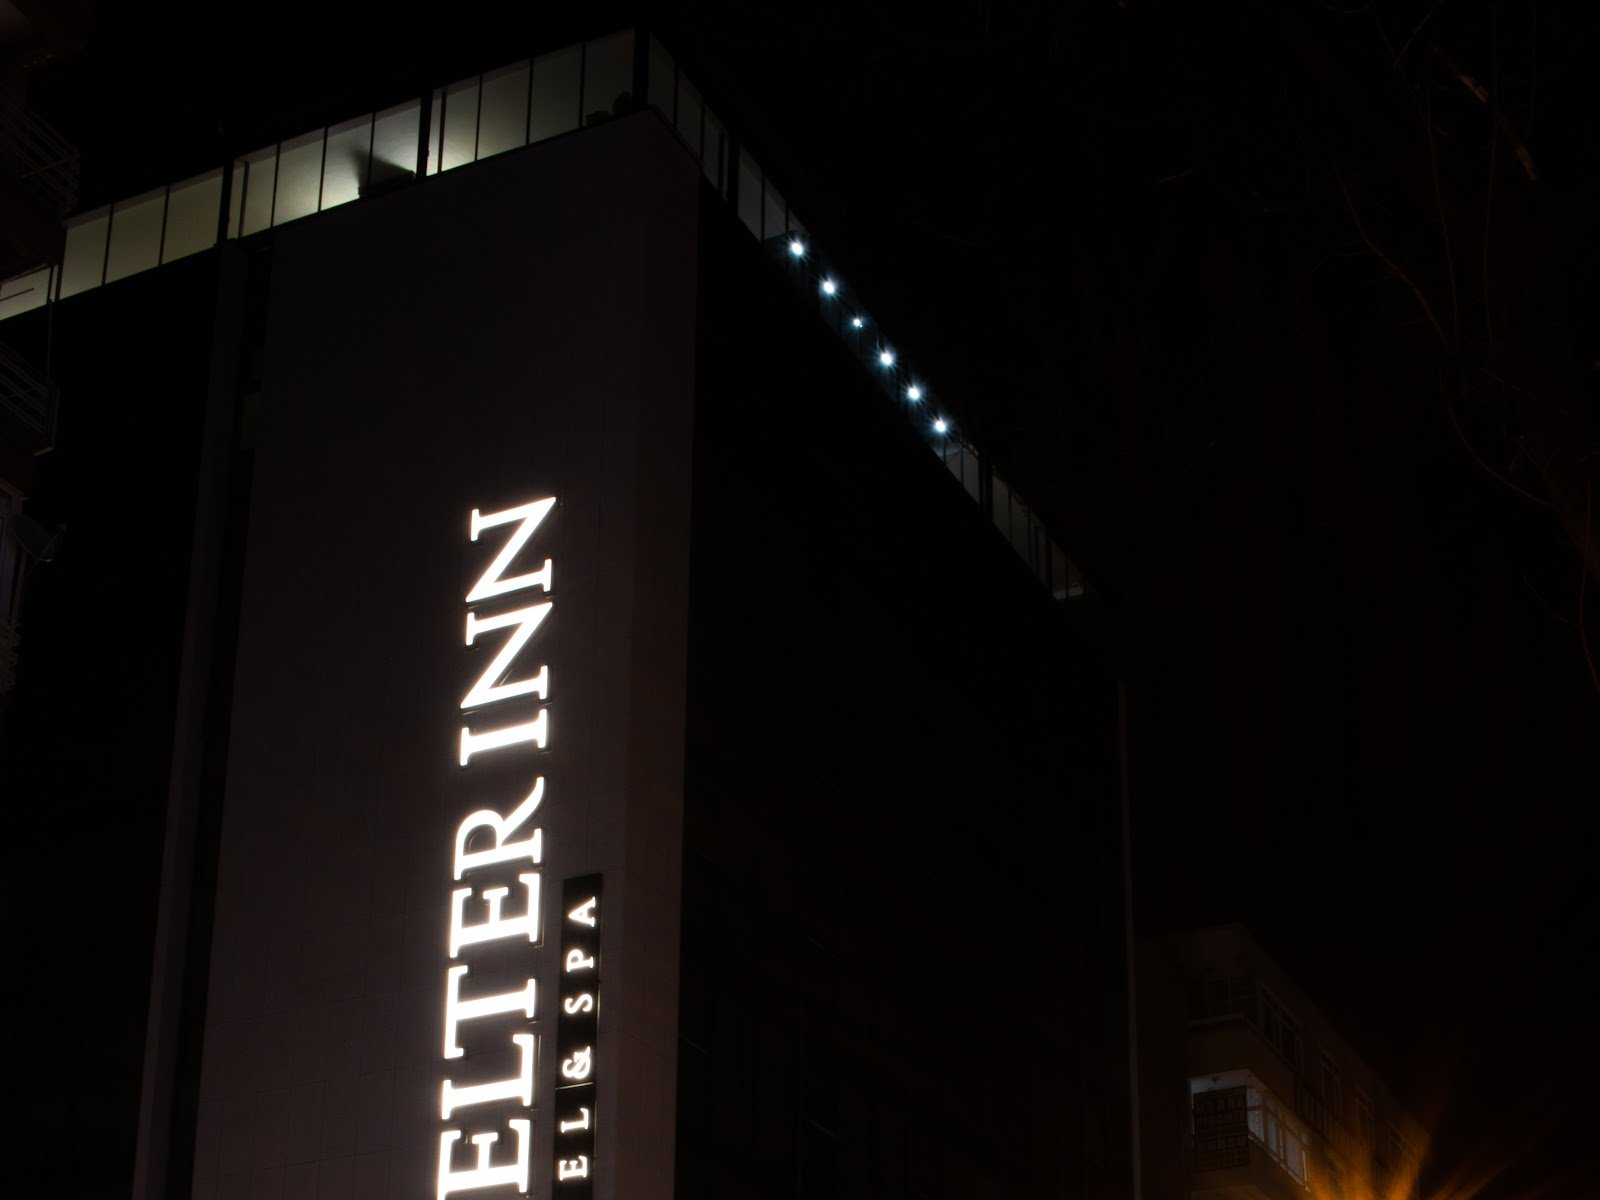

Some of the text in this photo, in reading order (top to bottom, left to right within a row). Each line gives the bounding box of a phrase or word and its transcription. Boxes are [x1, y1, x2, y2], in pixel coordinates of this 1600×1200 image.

[459, 497, 556, 766] INN
[565, 896, 597, 1016] SPA
[562, 1045, 593, 1080] &
